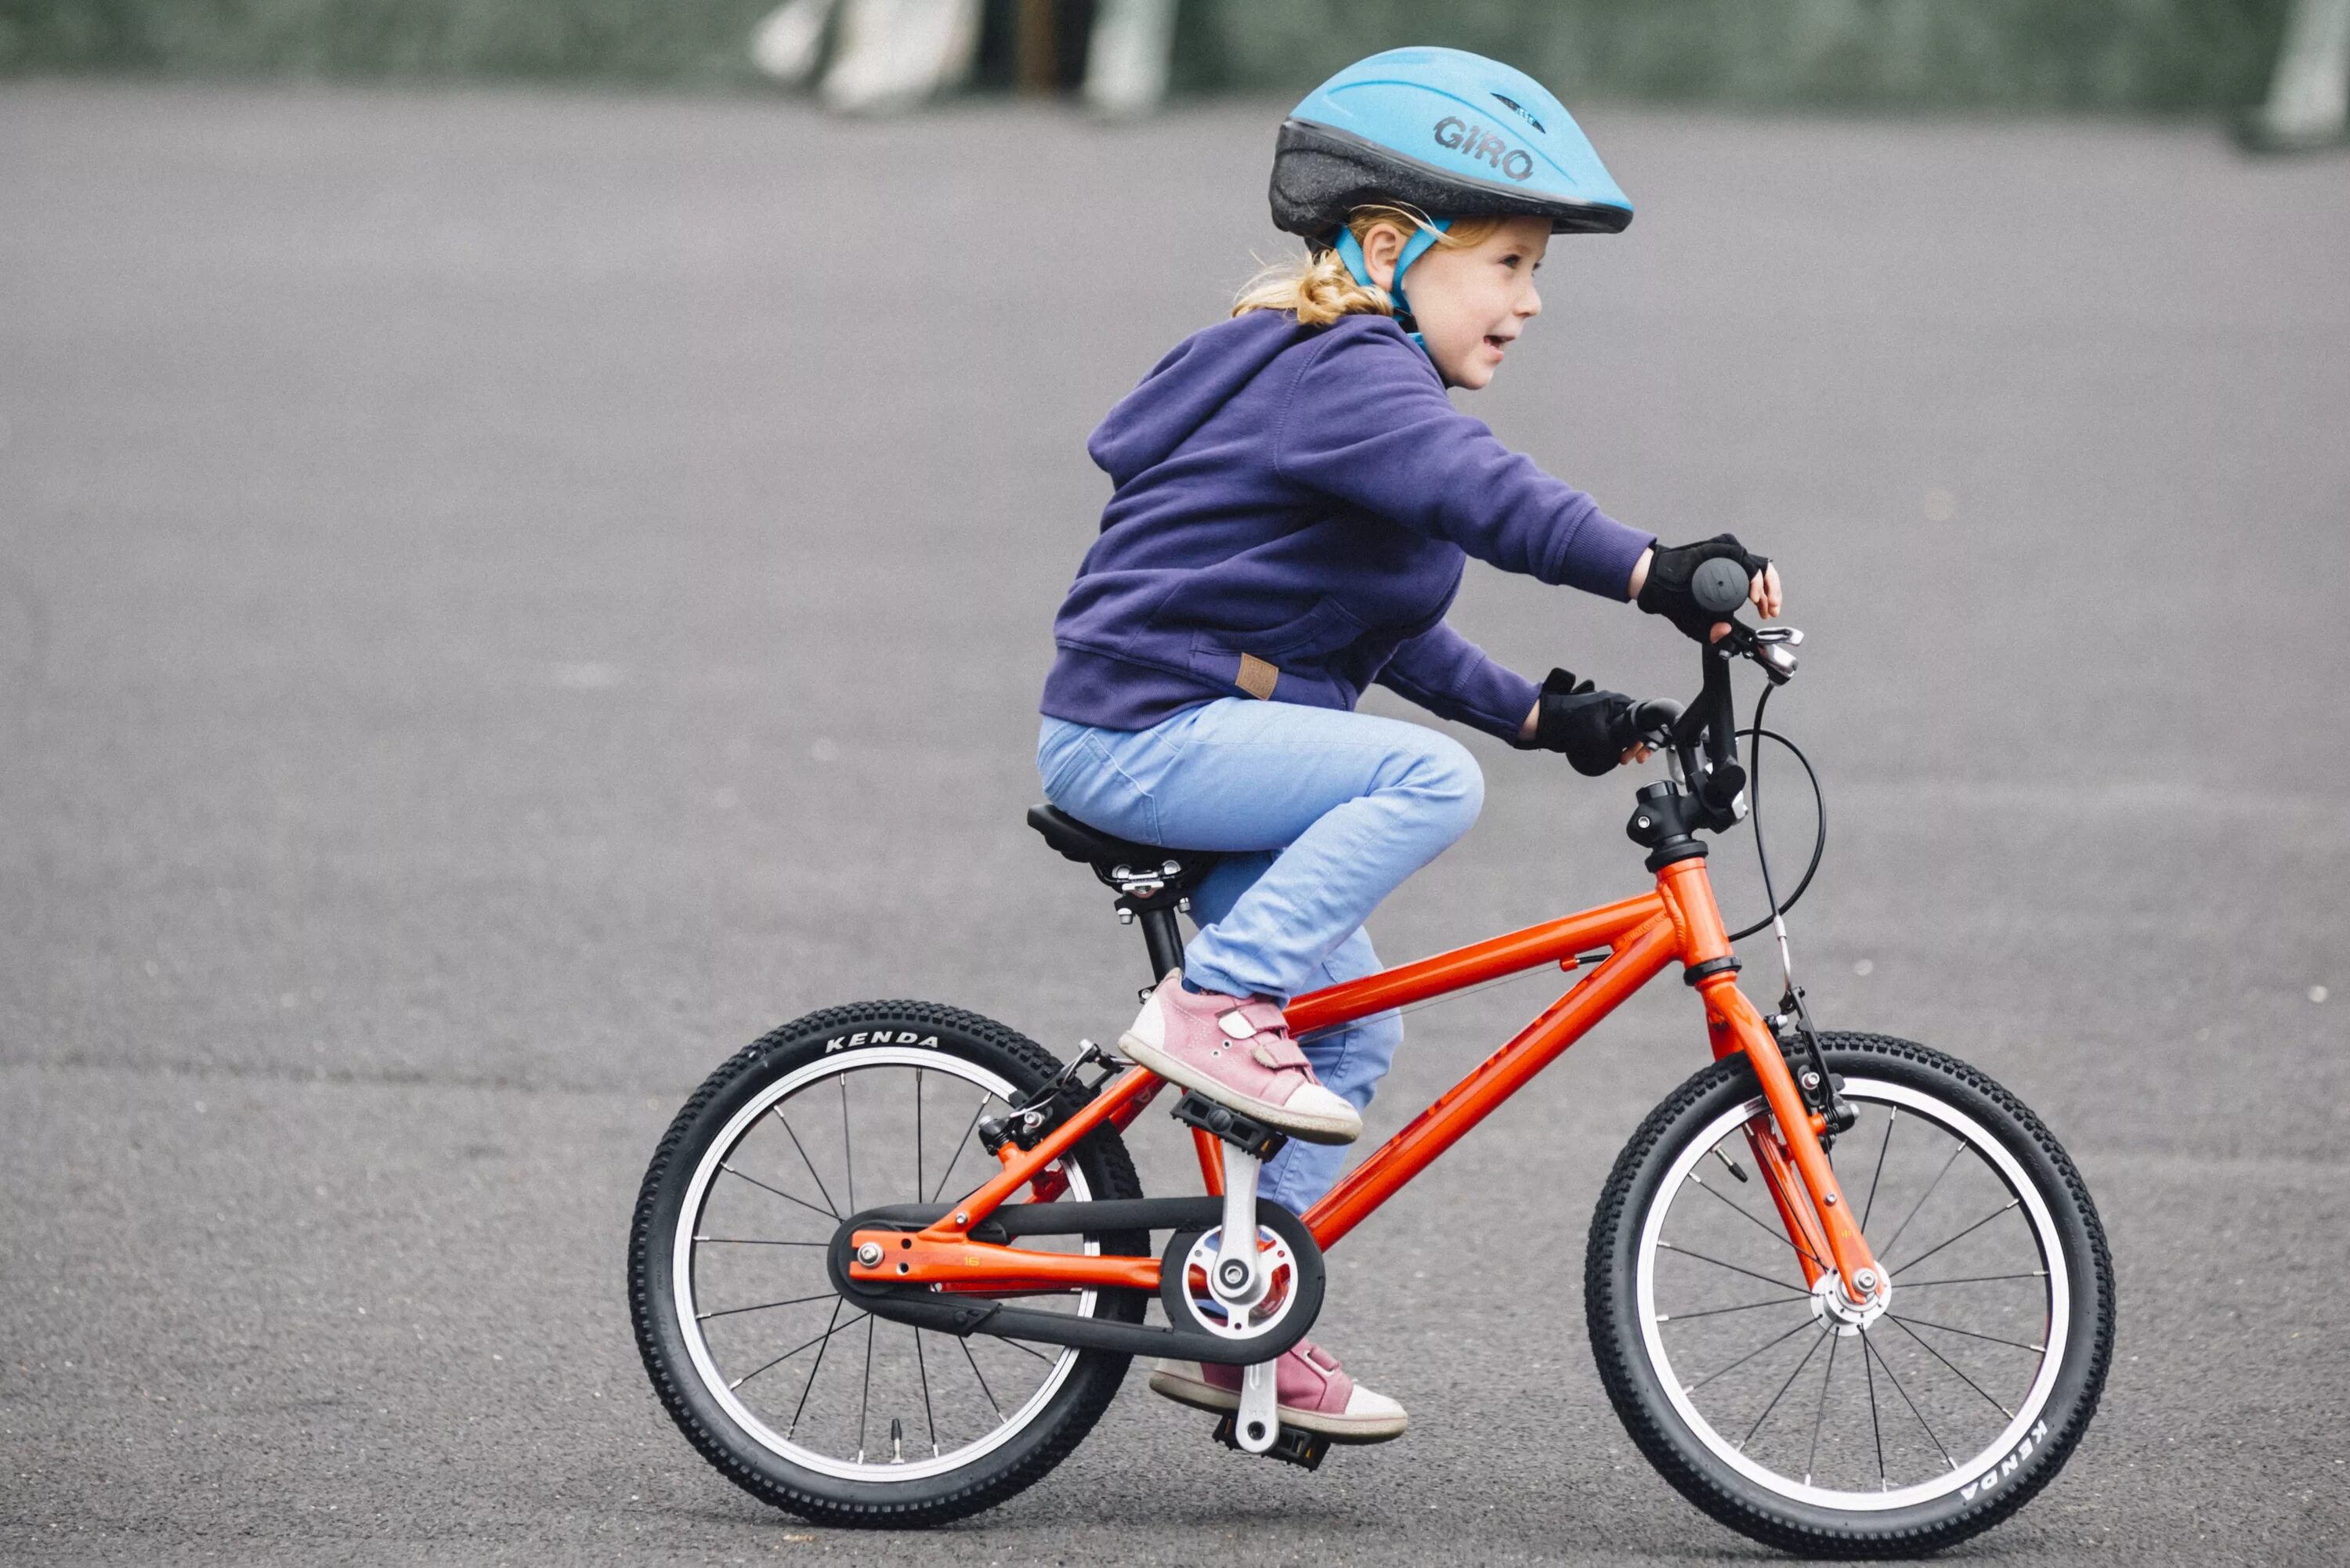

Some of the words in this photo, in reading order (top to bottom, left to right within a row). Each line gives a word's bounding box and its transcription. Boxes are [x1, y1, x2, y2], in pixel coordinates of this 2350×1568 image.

[1434, 116, 1535, 181] GIRO
[825, 1031, 939, 1053] KENDA
[1960, 1419, 2048, 1501] KENDA
